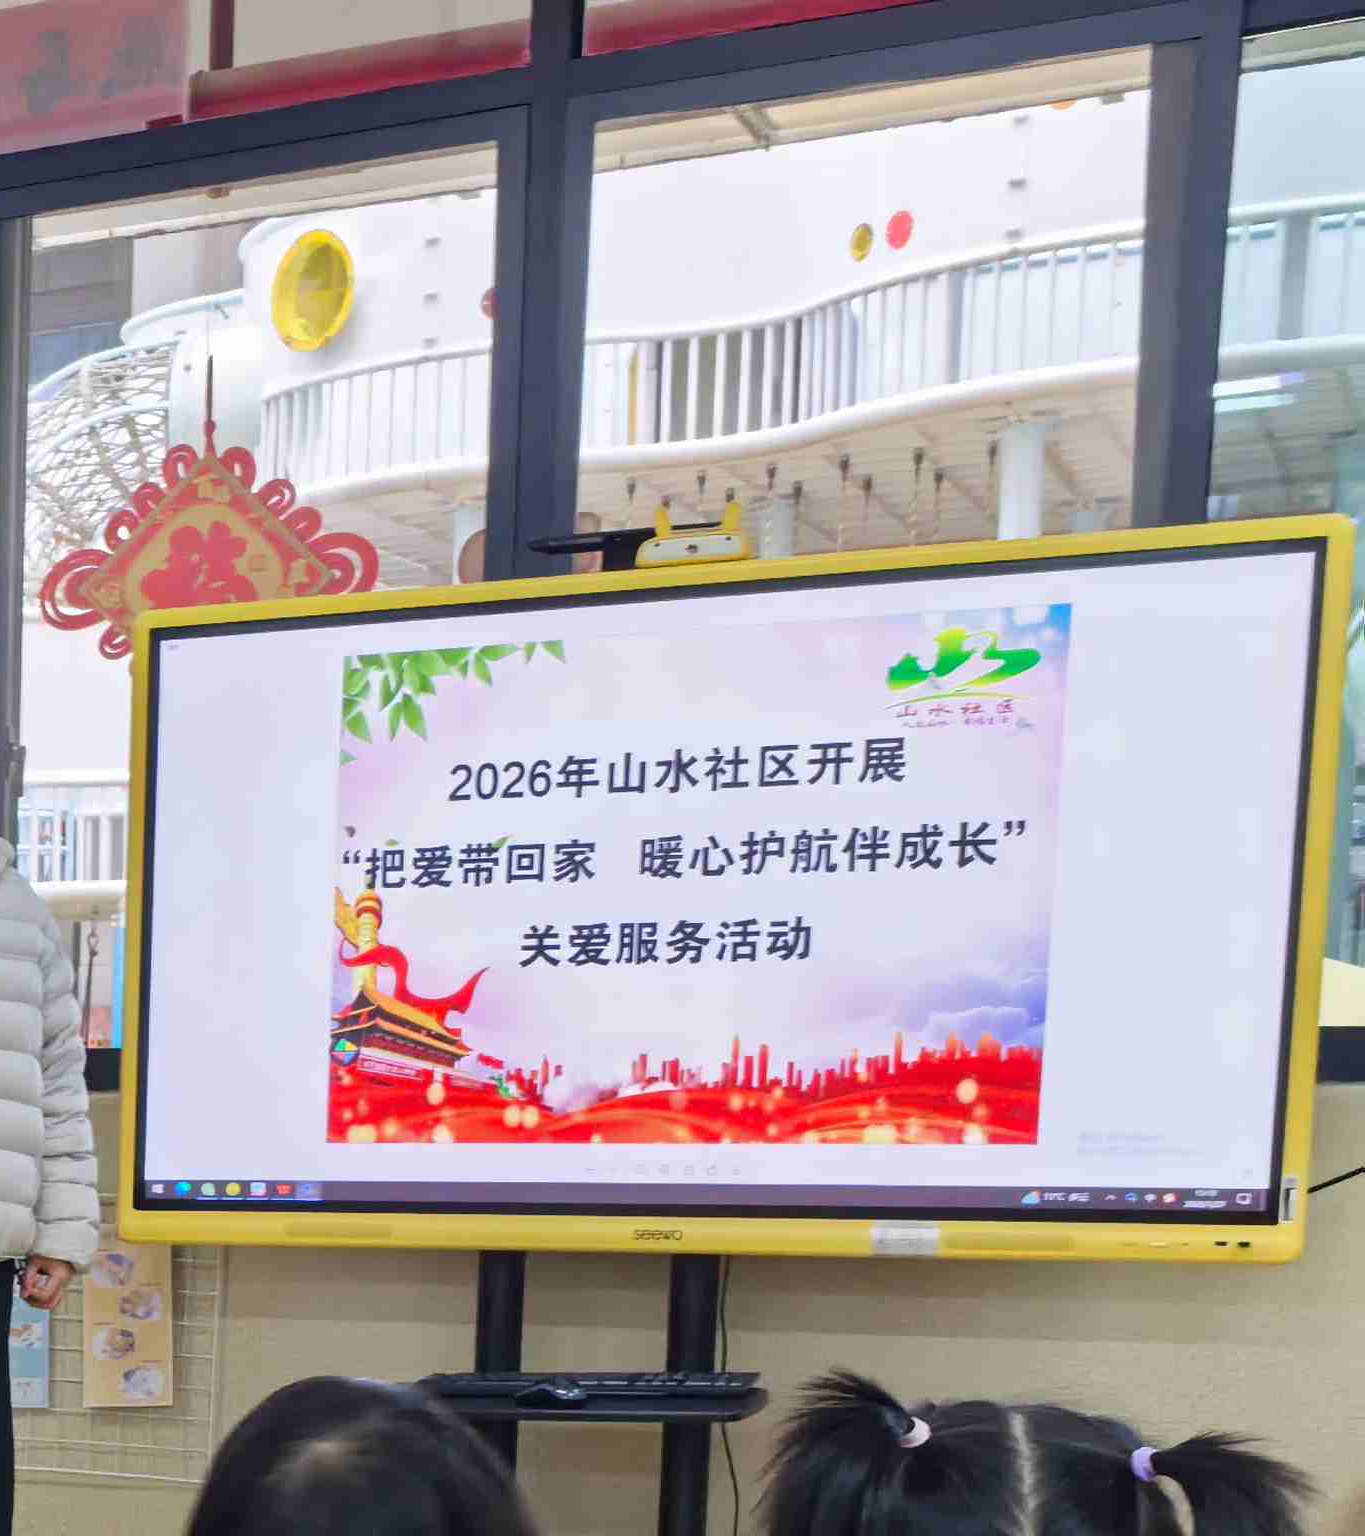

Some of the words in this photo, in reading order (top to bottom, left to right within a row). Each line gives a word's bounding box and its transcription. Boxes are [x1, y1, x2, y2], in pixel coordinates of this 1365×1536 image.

[448, 737, 906, 801] 2026年山水社区开展
[342, 839, 596, 889] “把爱带回家
[638, 820, 1027, 879] 暖心护航伴成长”
[519, 916, 812, 967] 关爱服务活动
[633, 1229, 684, 1241] seewo
